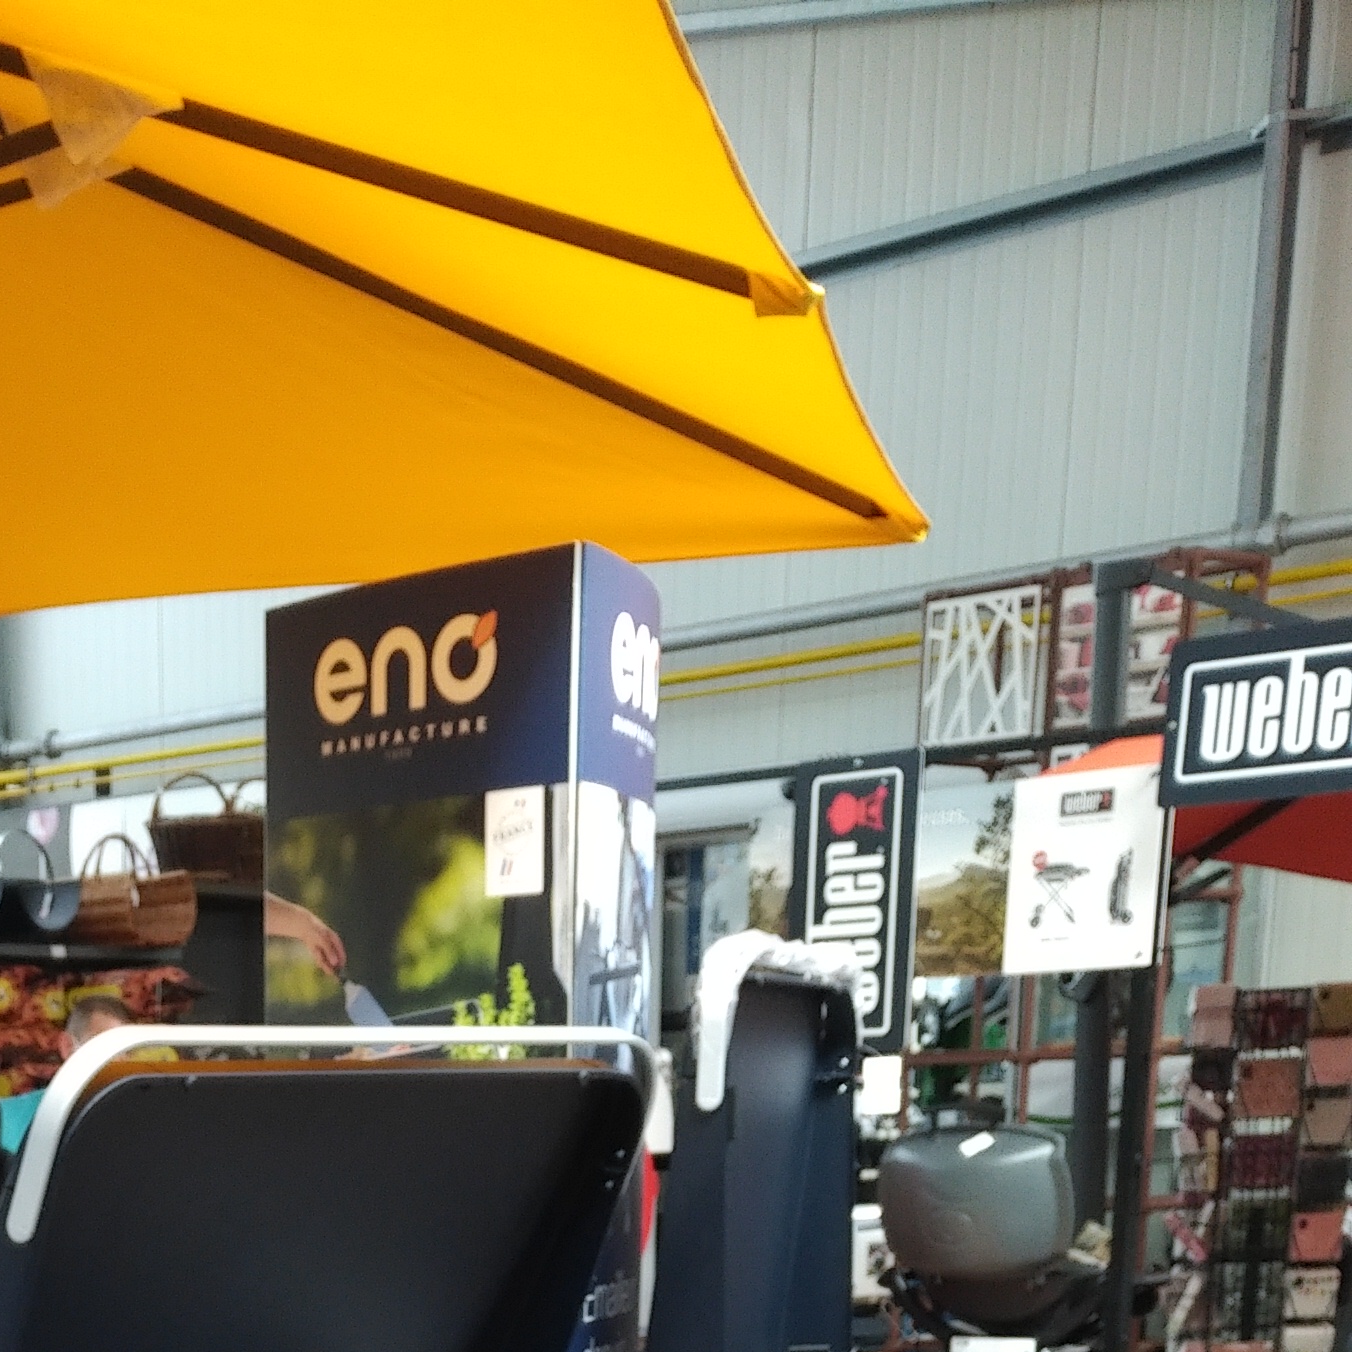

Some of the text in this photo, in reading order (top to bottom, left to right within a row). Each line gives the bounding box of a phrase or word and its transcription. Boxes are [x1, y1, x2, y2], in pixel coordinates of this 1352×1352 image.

[314, 610, 498, 726] eno
[1200, 650, 1352, 763] webe
[320, 714, 489, 758] MANUFACTURE
